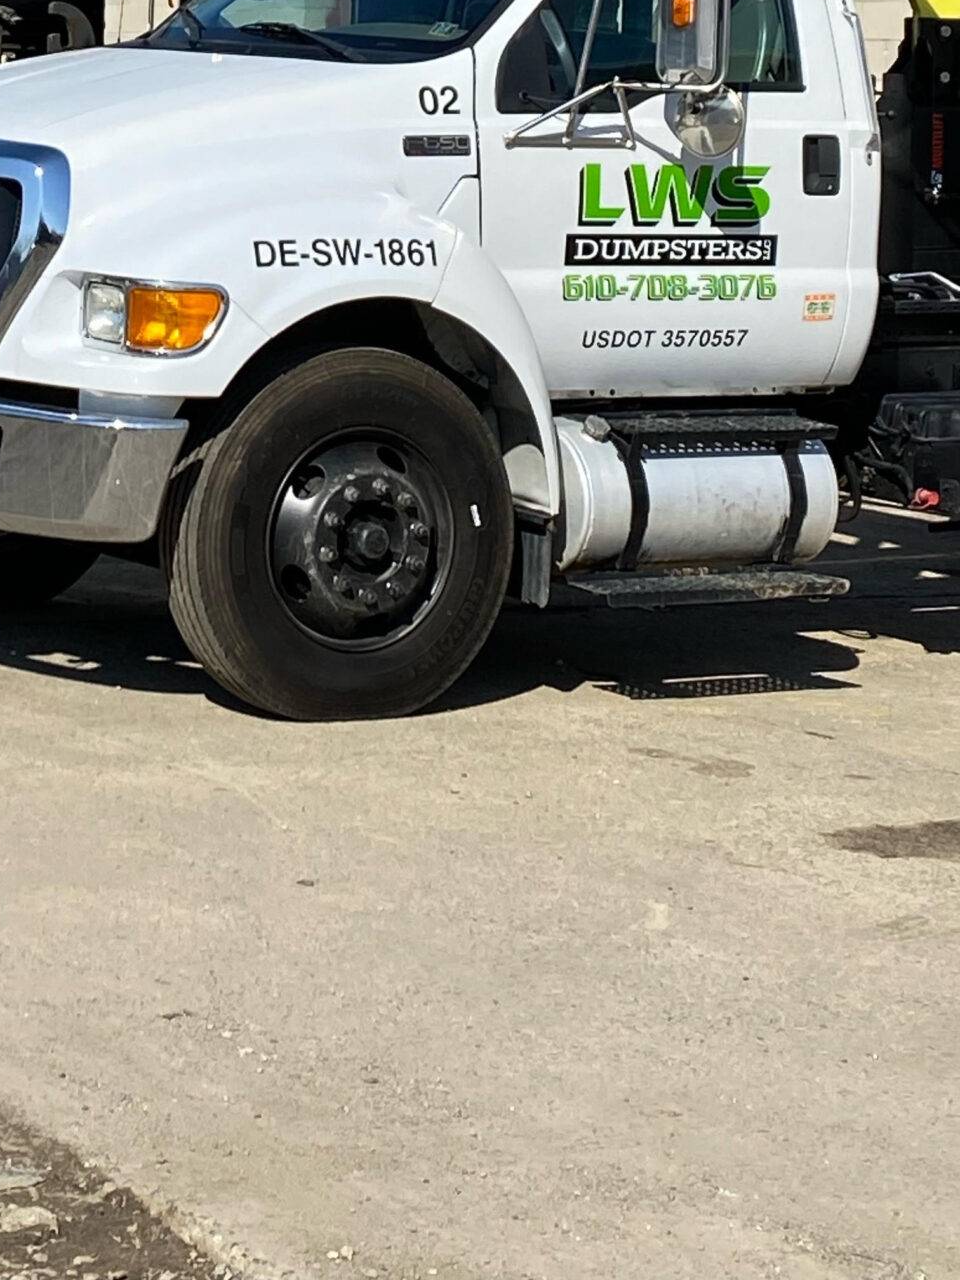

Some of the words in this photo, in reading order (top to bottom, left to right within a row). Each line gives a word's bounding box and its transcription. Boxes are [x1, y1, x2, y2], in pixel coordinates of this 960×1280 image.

[418, 86, 461, 115] 02
[578, 163, 772, 227] LWS
[253, 238, 438, 267] DE-SW-1861
[573, 238, 763, 260] DUMPSTERS
[563, 274, 778, 301] 610-708-3076
[581, 330, 656, 348] USDOT
[661, 329, 749, 348] 3570557
